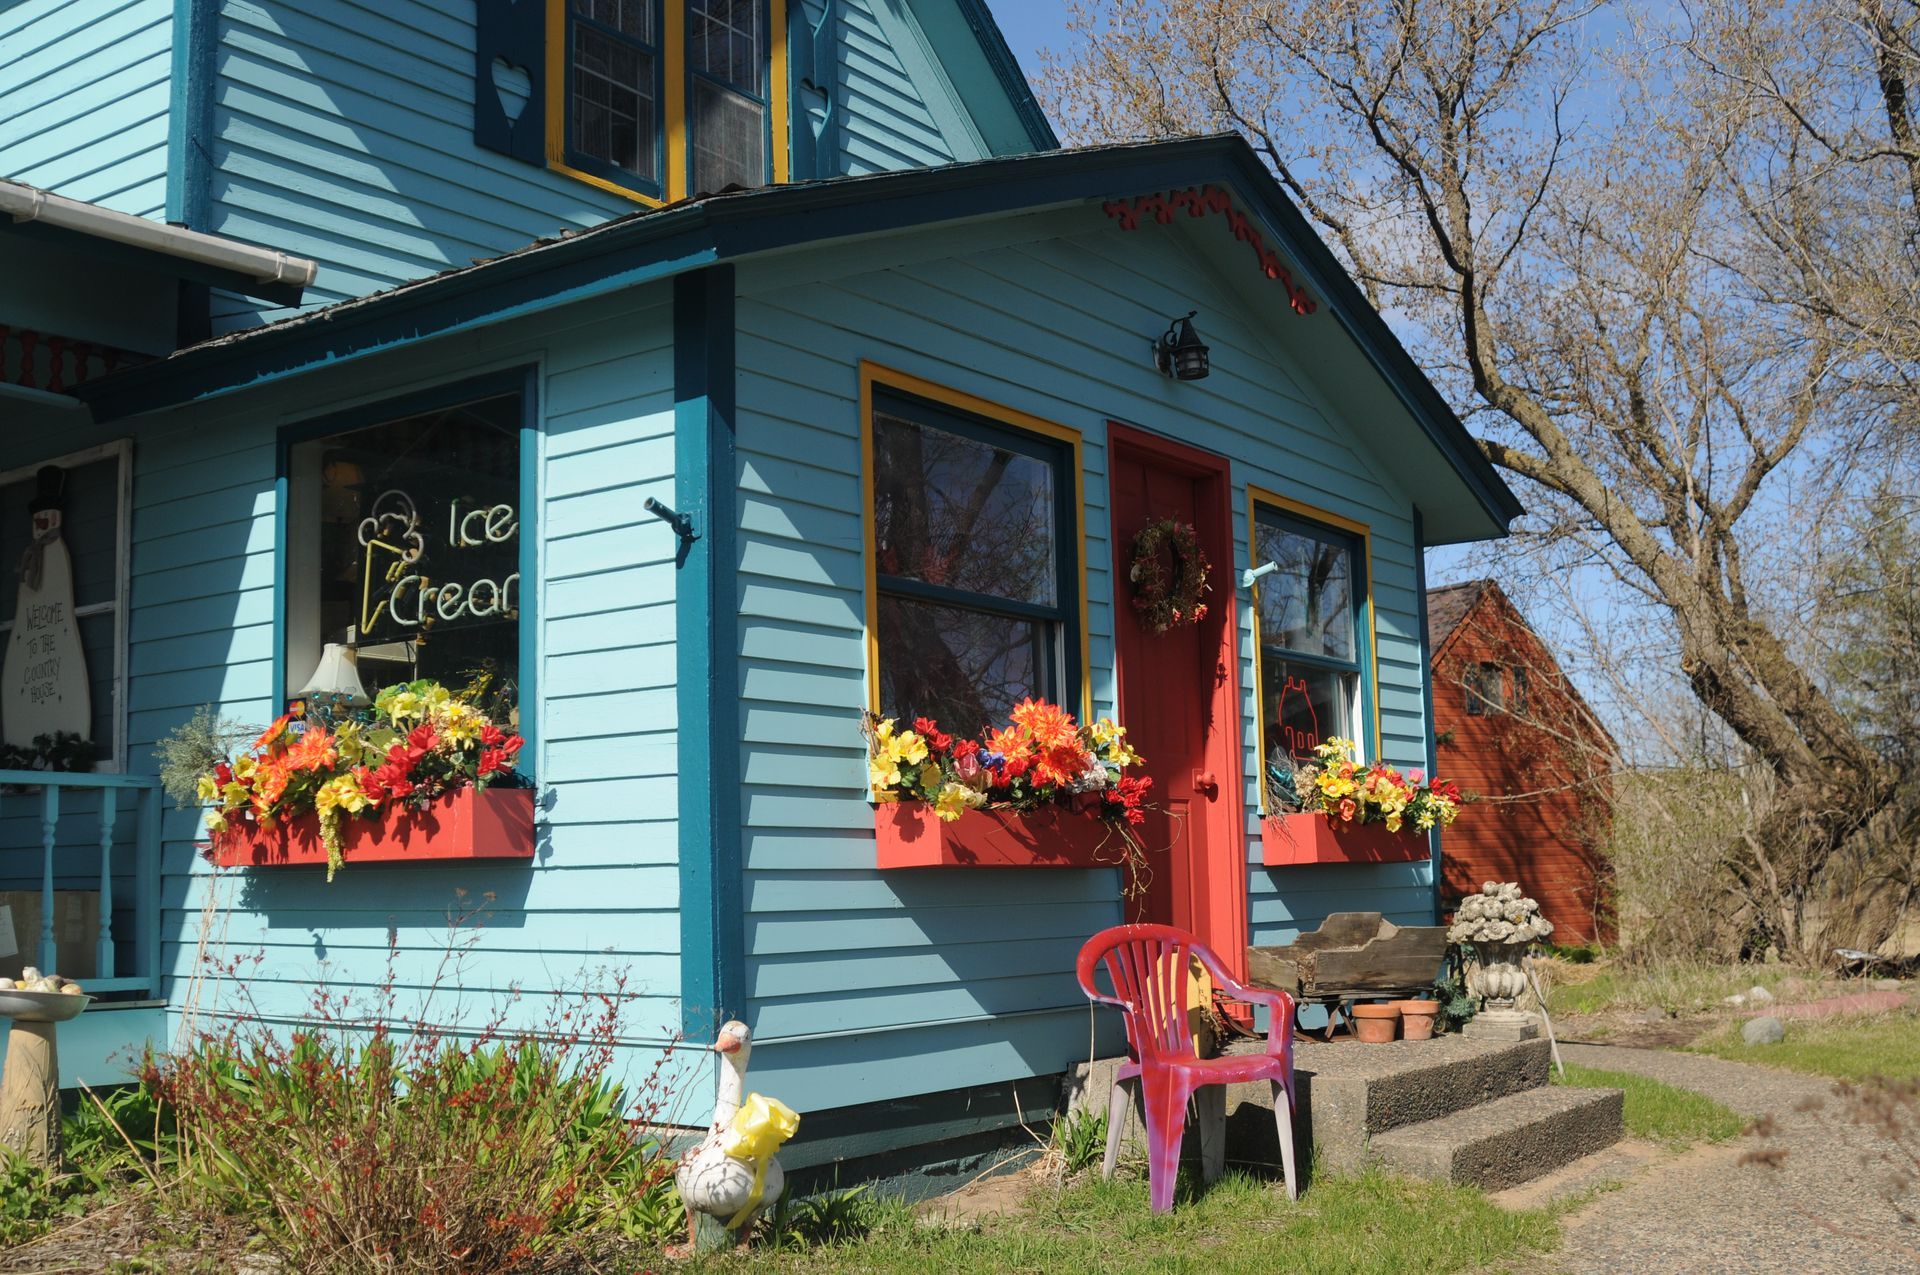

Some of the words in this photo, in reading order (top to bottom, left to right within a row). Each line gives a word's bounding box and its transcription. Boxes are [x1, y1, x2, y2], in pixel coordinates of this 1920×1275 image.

[450, 498, 519, 547] Ice
[26, 602, 64, 631] WELCOME
[27, 638, 38, 659] TO
[40, 634, 56, 655] THE
[24, 657, 61, 684] COUNTRY
[31, 682, 55, 703] HOUSE
[290, 723, 305, 732] VISA
